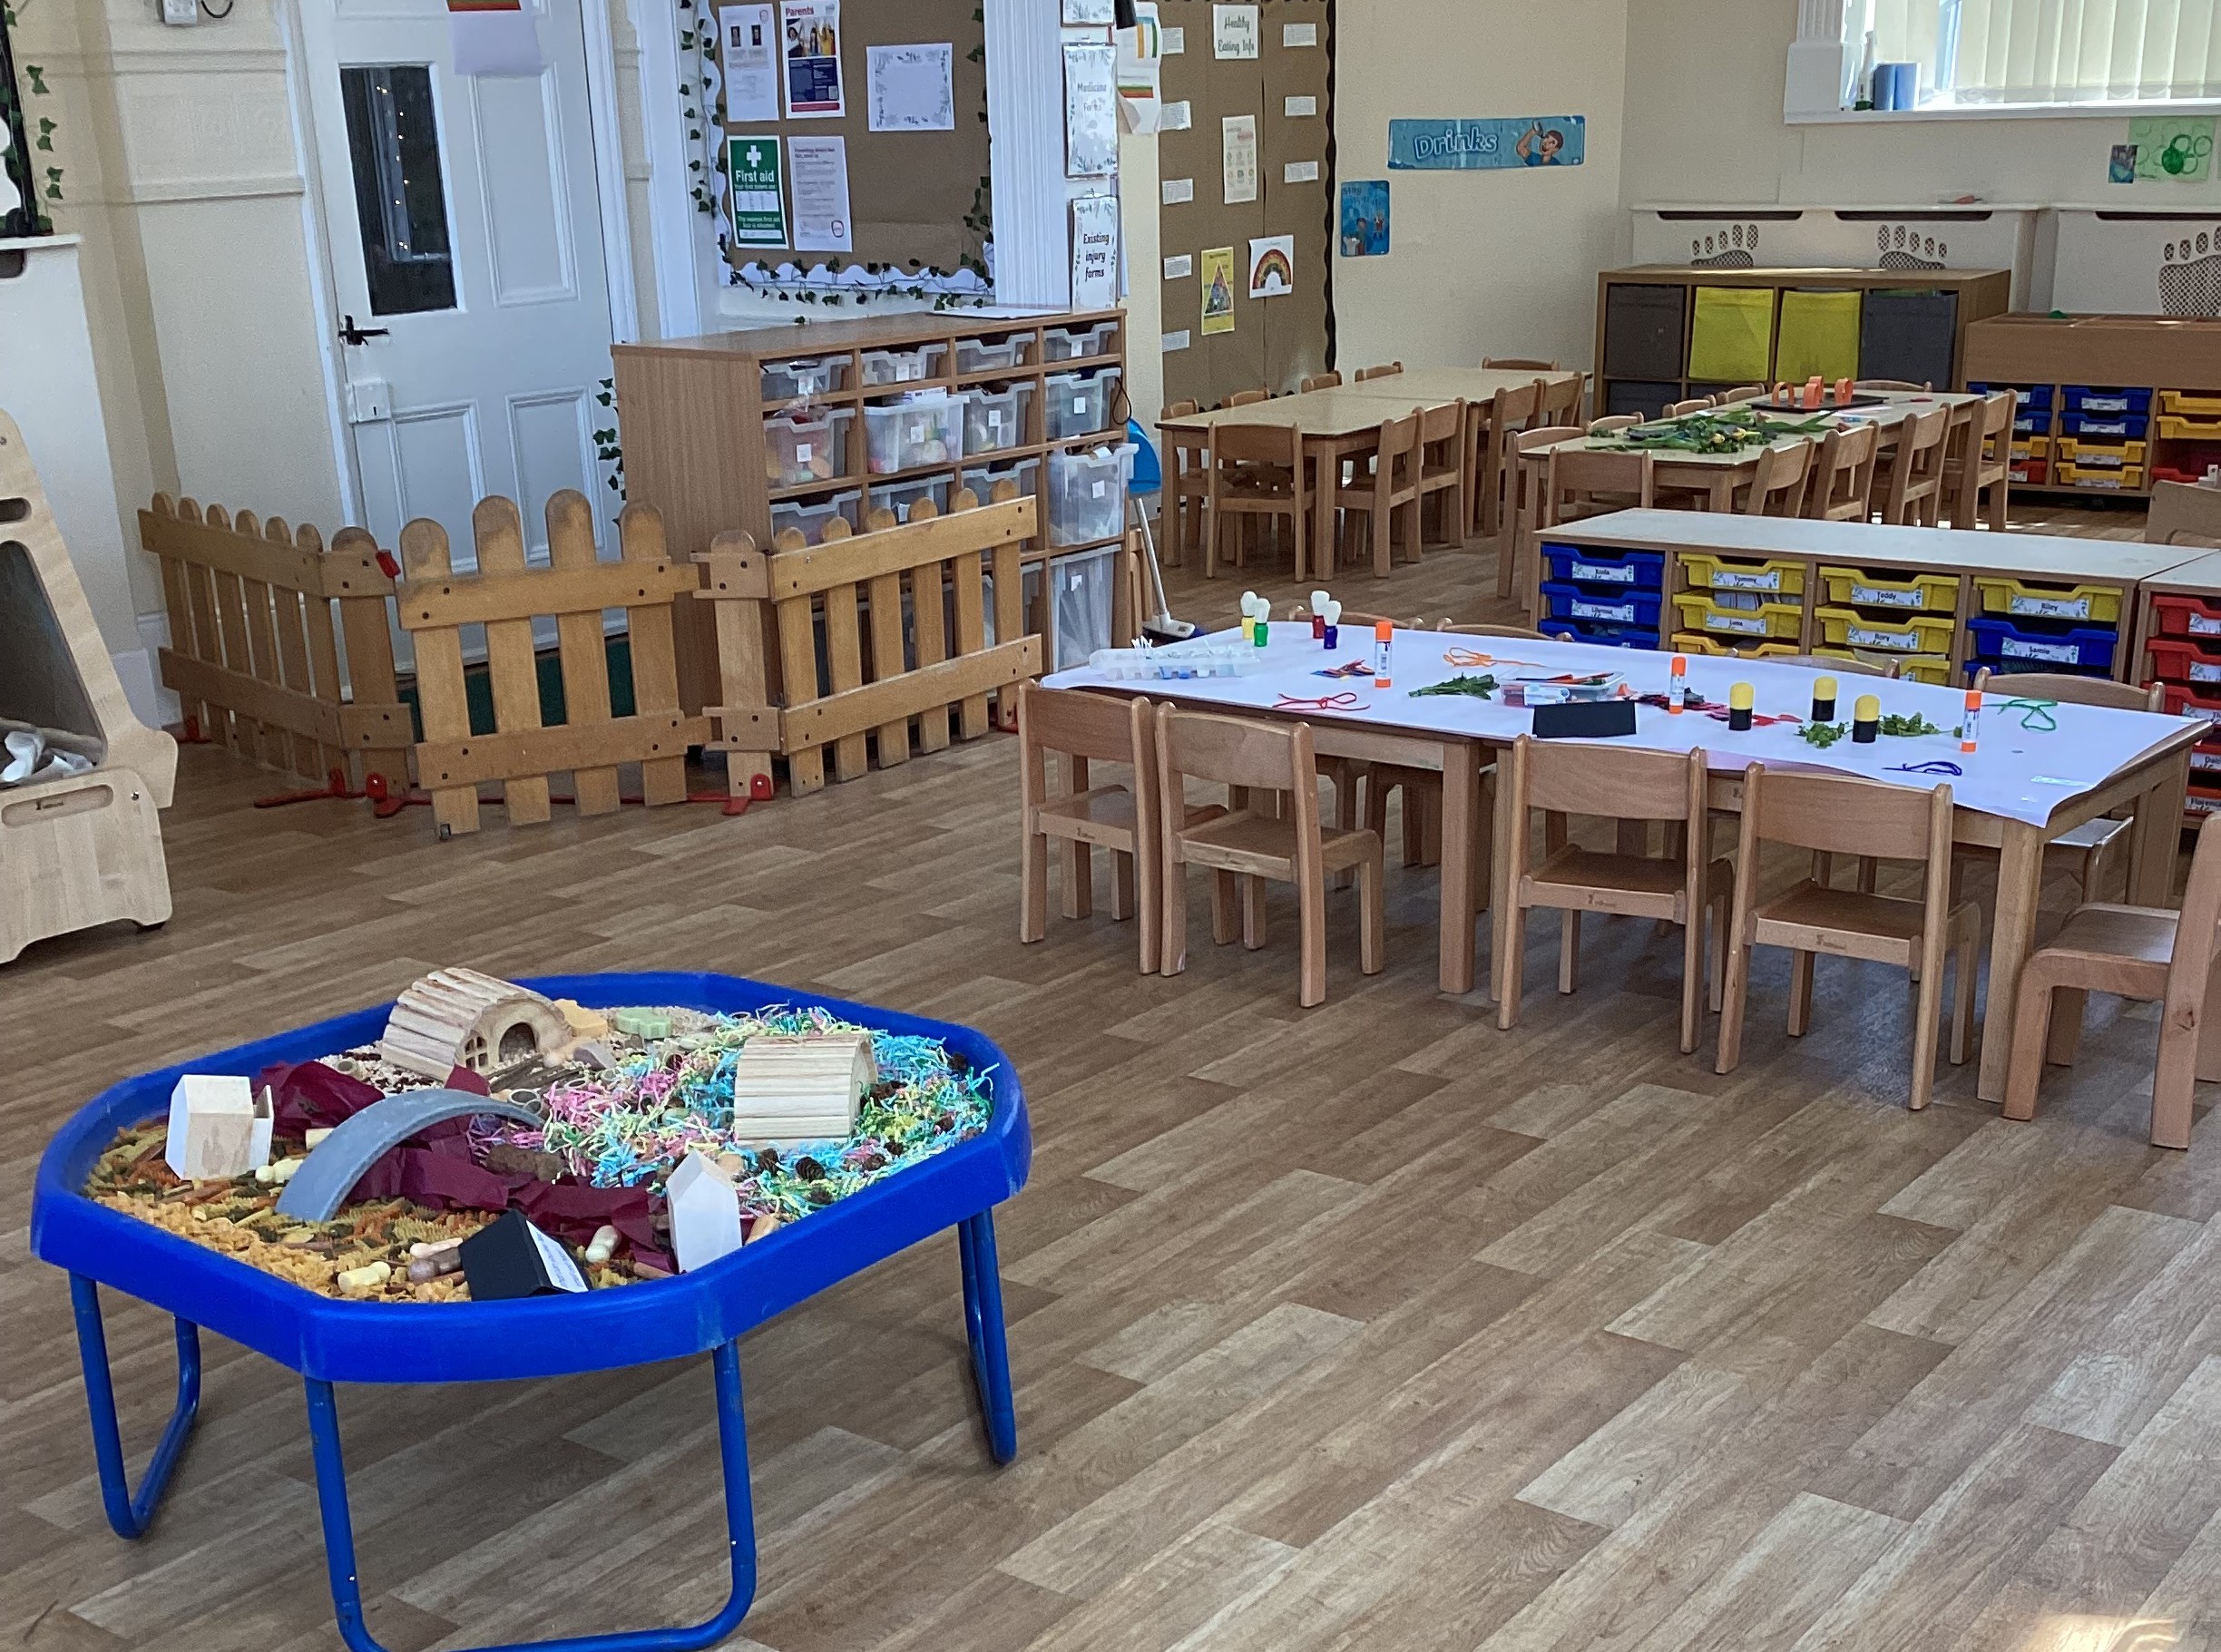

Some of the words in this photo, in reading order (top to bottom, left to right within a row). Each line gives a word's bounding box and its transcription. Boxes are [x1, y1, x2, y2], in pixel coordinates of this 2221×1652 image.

[786, 6, 814, 16] Parents
[1224, 15, 1249, 34] Healthy
[1218, 39, 1239, 56] Eating
[1414, 125, 1498, 160] Drinks
[735, 170, 758, 182] First
[759, 170, 775, 182] aid
[1083, 232, 1110, 245] Existing
[1085, 250, 1106, 264] injury
[1084, 267, 1105, 282] forms
[1876, 591, 1897, 601] Teddy
[1874, 633, 1891, 642] Rory
